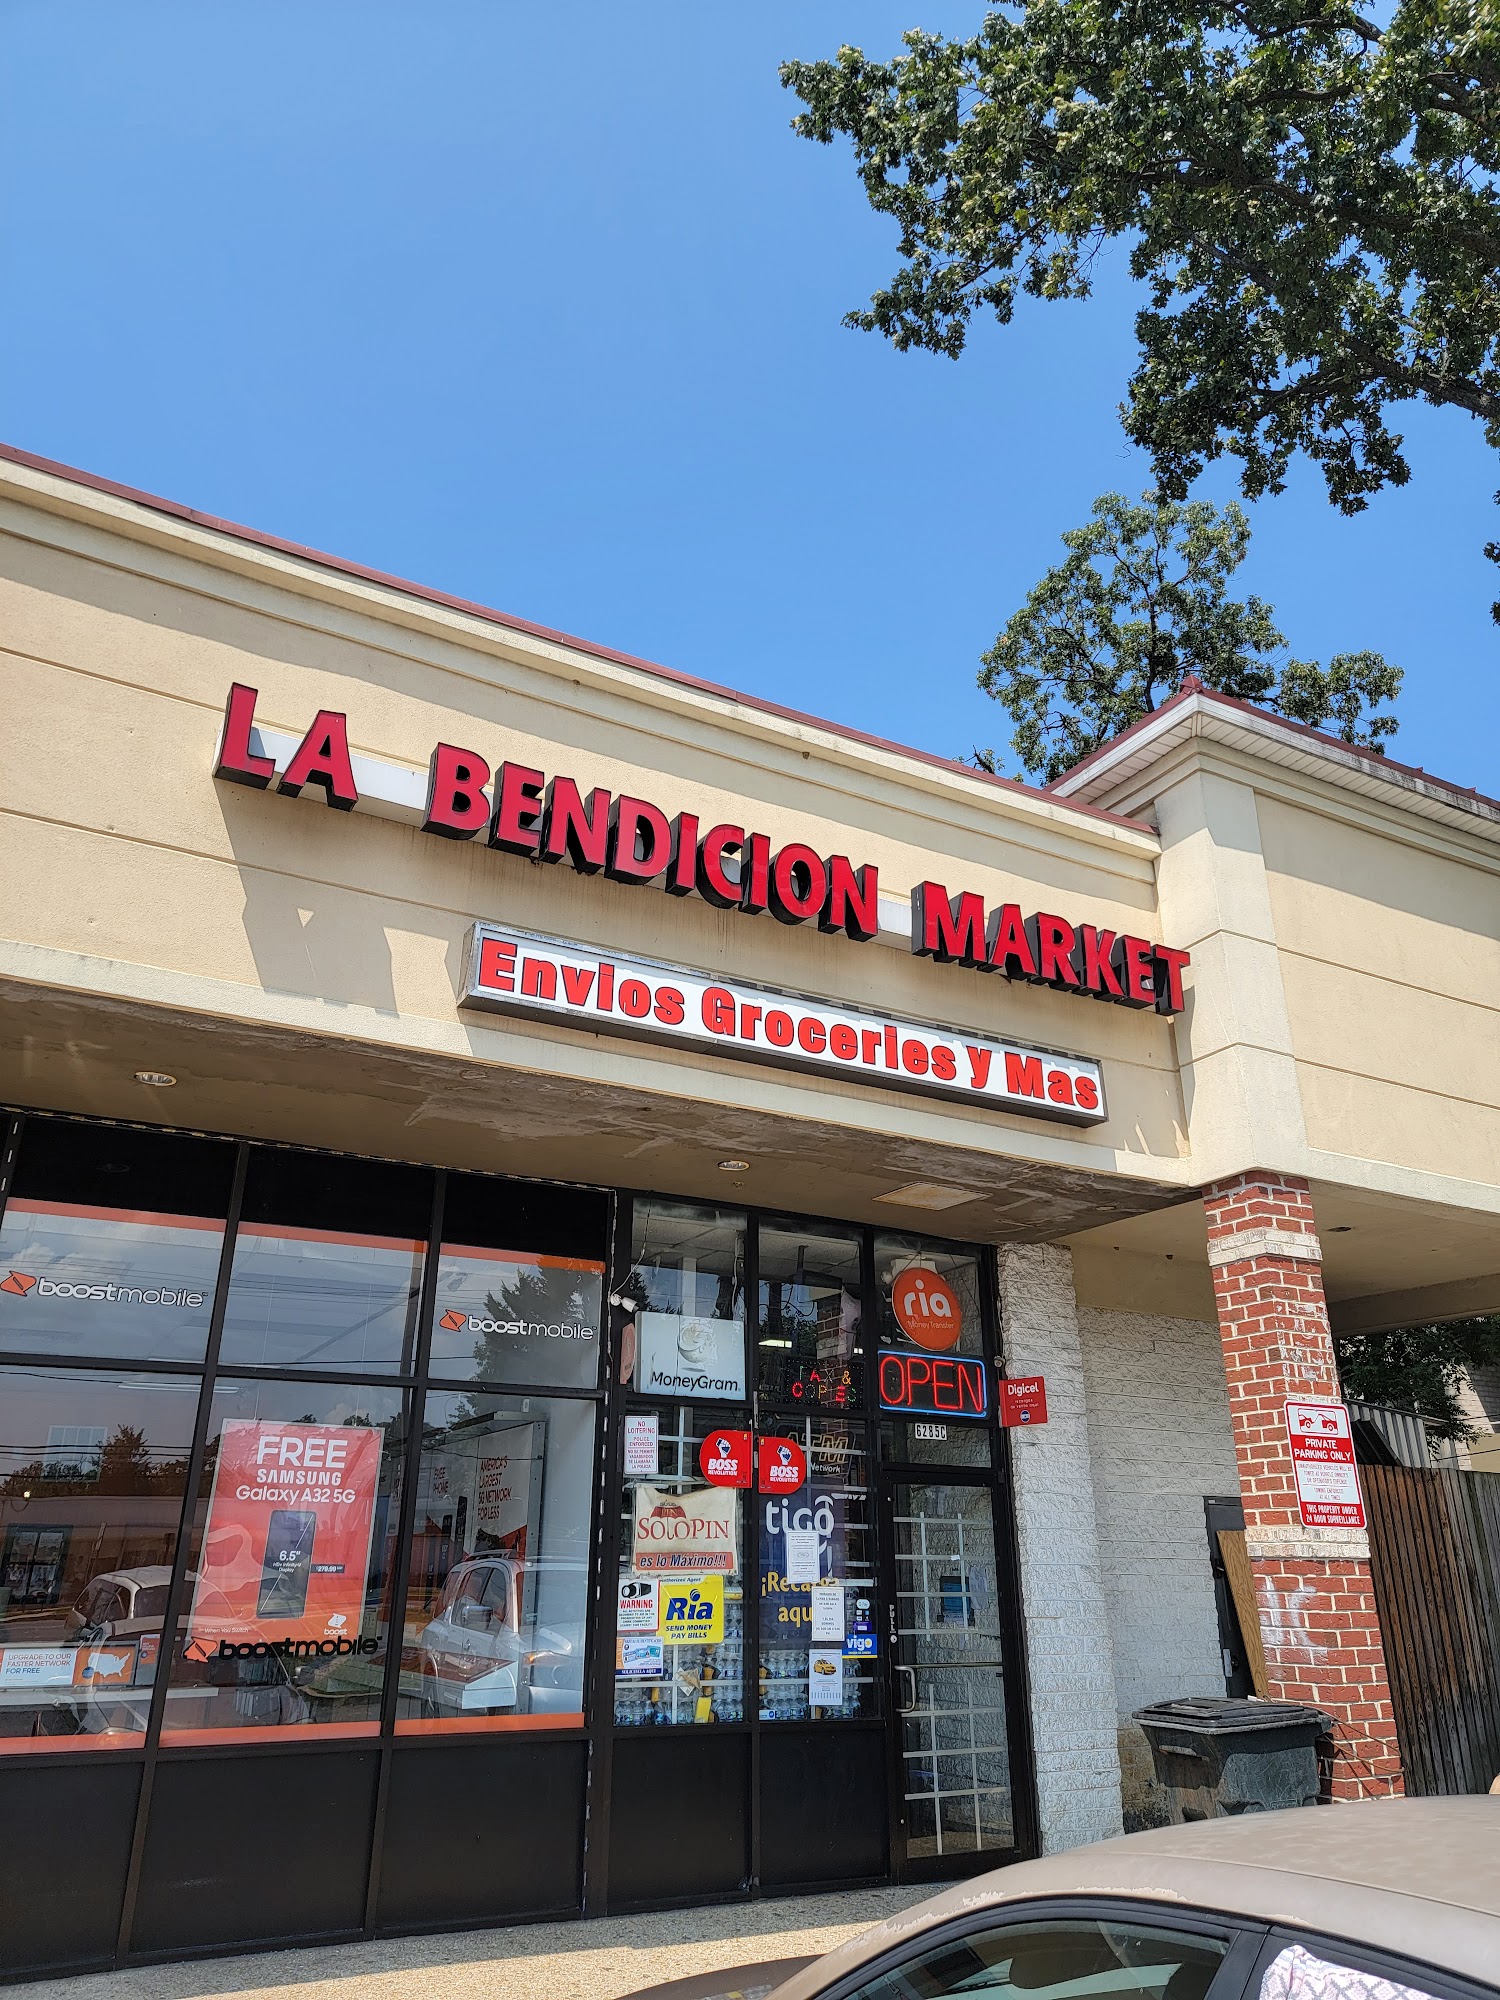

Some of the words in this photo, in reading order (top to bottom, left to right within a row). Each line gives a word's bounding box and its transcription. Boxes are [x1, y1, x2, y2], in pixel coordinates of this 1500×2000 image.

[215, 682, 358, 810] LA
[422, 742, 878, 939] BENDICION
[913, 881, 1190, 1014] MARKET
[478, 937, 685, 1025] Envios
[701, 986, 957, 1081] Groceries
[967, 1045, 992, 1089] y
[1005, 1052, 1099, 1110] Mas
[903, 1279, 952, 1317] ria
[908, 1320, 930, 1329] Money
[930, 1321, 954, 1329] Transfer
[651, 1372, 738, 1391] MoneyGram
[842, 1370, 852, 1384] &
[880, 1356, 982, 1412] OPEN
[1008, 1382, 1039, 1396] Digicel
[916, 1424, 946, 1438] 6285C
[256, 1435, 348, 1468] FREE
[1305, 1438, 1338, 1449] PRIVATE
[1294, 1448, 1328, 1460] PARKING
[1330, 1452, 1351, 1461] ONLY
[480, 1455, 508, 1472] AMERICA'S
[708, 1458, 738, 1470] BOSS
[811, 1464, 841, 1474] Network
[256, 1468, 342, 1486] SAMSUNG
[770, 1466, 799, 1478] BOSS
[479, 1472, 502, 1489] LARGEST
[236, 1484, 300, 1506] Galaxy
[300, 1487, 331, 1503] A32
[332, 1488, 356, 1504] 5G
[485, 1486, 512, 1504] NETWORK
[477, 1506, 488, 1520] FOR
[488, 1506, 500, 1519] LESS
[1306, 1504, 1317, 1512] THIS
[1318, 1505, 1340, 1514] PROPERTY
[1341, 1506, 1358, 1514] UNDER
[1306, 1514, 1312, 1522] 24
[1313, 1515, 1326, 1523] HOUR
[640, 1557, 653, 1567] es
[656, 1555, 667, 1567] lo
[762, 1571, 838, 1596] ¡Reca
[620, 1600, 653, 1609] WARNING
[666, 1588, 713, 1621] Ria
[778, 1606, 812, 1628] aqu
[888, 1605, 896, 1633] PULL
[847, 1635, 872, 1651] vigo
